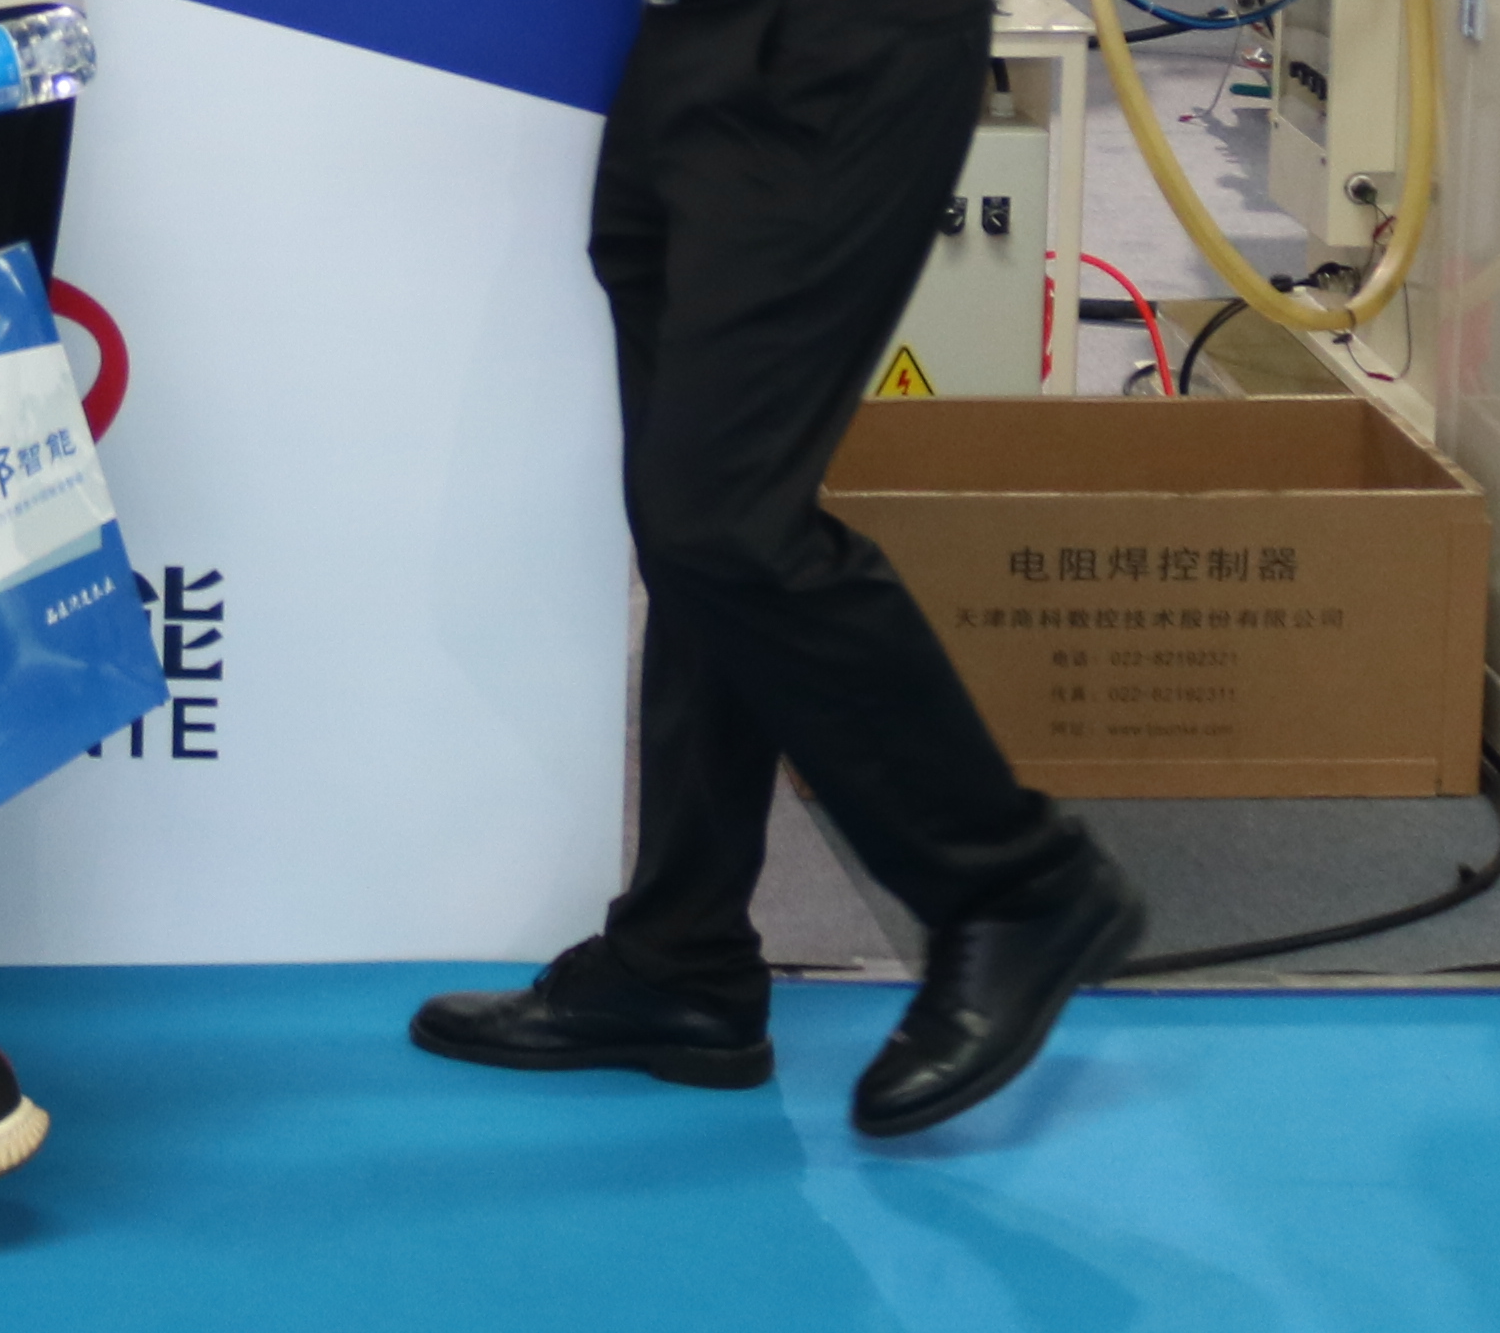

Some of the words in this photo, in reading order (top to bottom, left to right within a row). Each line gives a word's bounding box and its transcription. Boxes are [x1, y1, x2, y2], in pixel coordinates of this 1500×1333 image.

[1009, 545, 1300, 583] 电阻焊控制器
